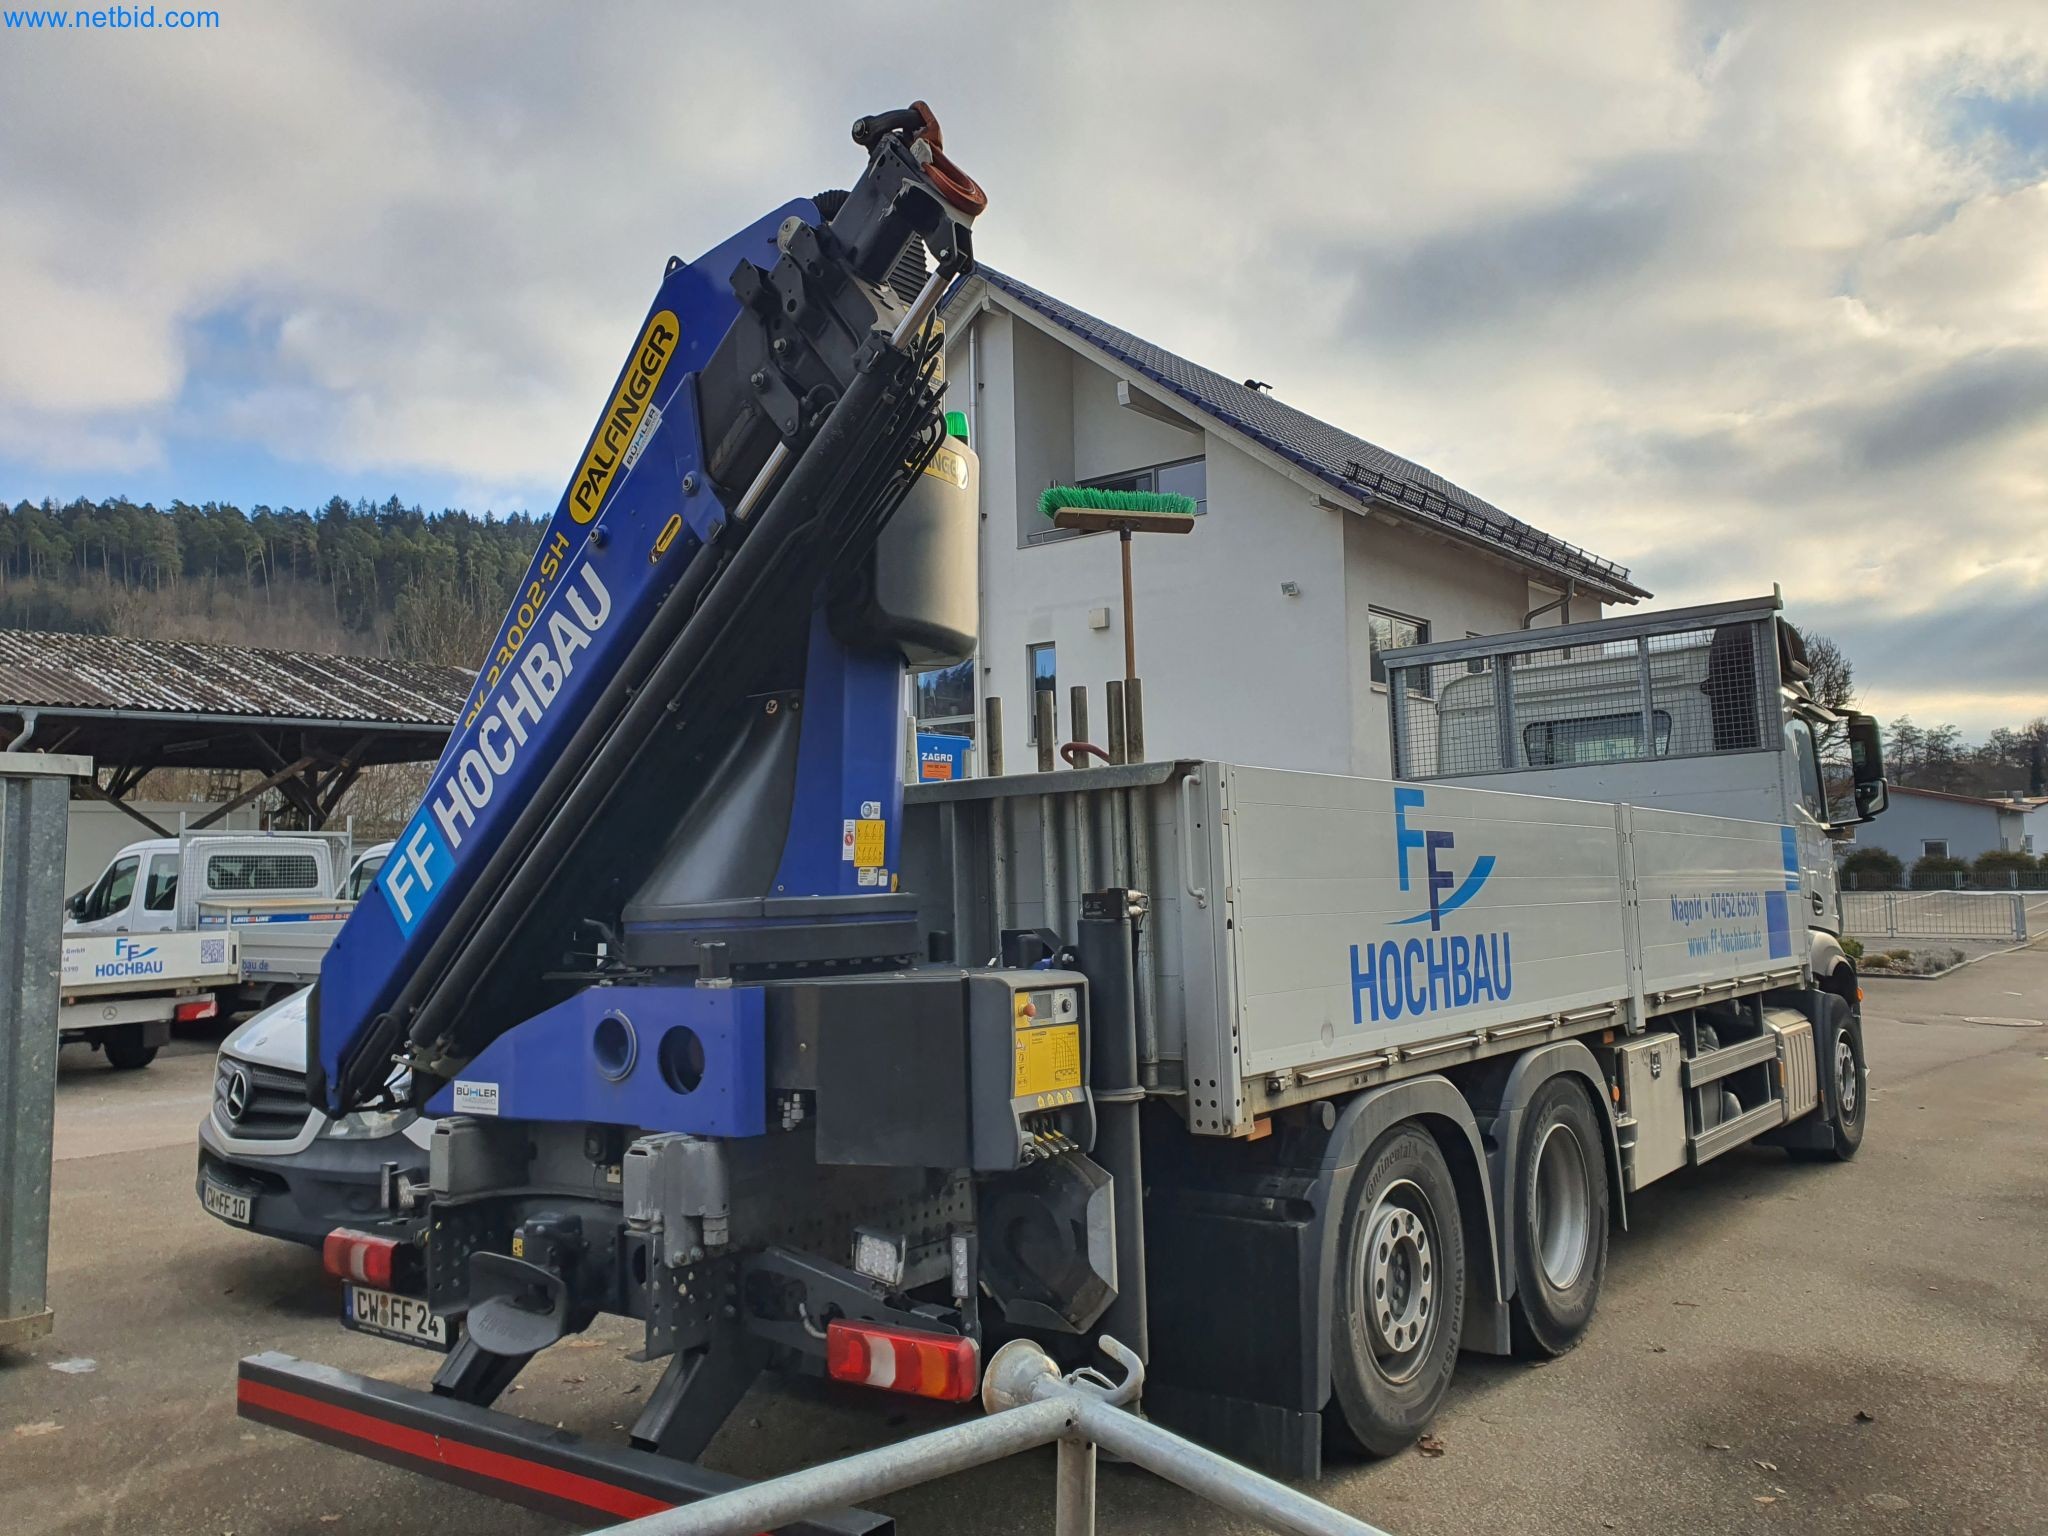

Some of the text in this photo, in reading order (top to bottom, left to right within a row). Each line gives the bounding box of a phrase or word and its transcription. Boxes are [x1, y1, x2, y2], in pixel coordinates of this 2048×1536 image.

[573, 323, 674, 513] PALFINGER
[626, 408, 657, 466] BÜHLER
[385, 560, 613, 923] FF HOCHBAU
[921, 752, 954, 763] ZAGRO
[1393, 787, 1455, 932] FF
[1671, 893, 1702, 926] Nagold
[1712, 893, 1735, 918] 07452
[115, 938, 141, 962] FF
[1688, 926, 1761, 957] www.ff-hochbau.de
[95, 960, 164, 977] HOCHBAU
[1349, 931, 1512, 1025] HOCHBAU
[455, 1084, 497, 1098] BÜHLER
[1365, 1141, 1412, 1204] Continental
[219, 1192, 231, 1214] FF
[232, 1197, 246, 1220] 10
[357, 1291, 379, 1323] CW
[391, 1298, 413, 1330] FF
[416, 1304, 439, 1338] 24
